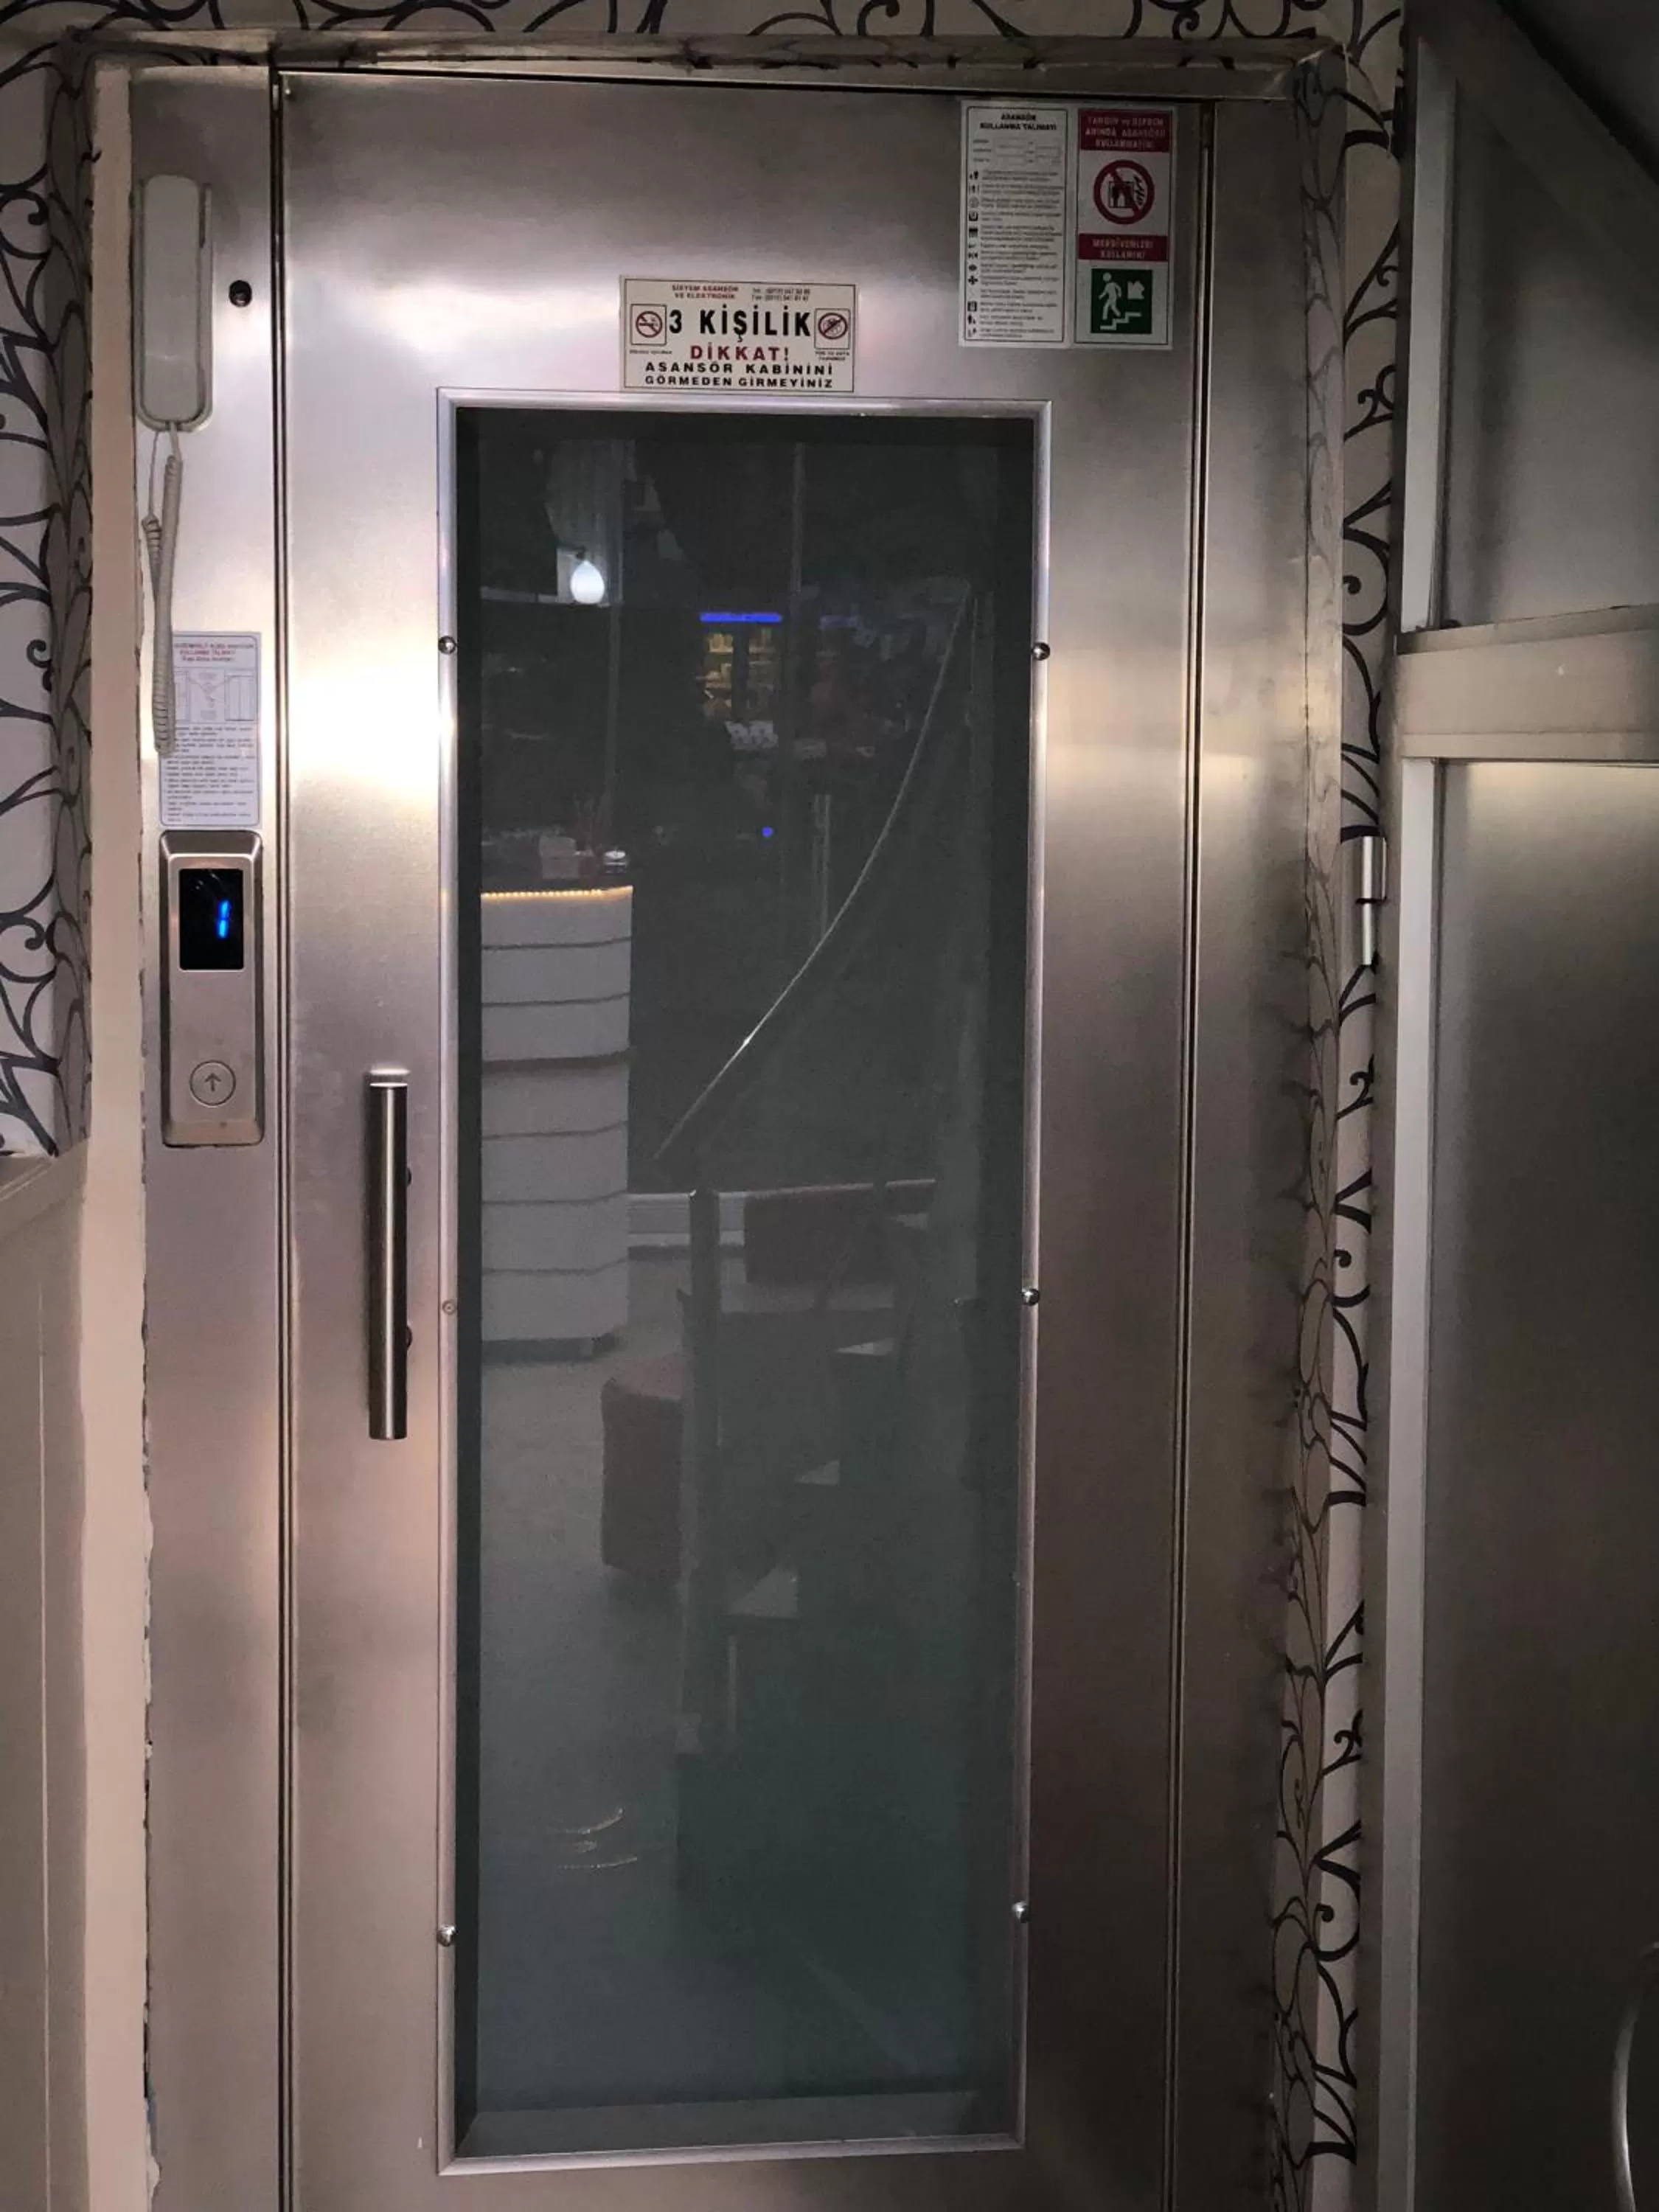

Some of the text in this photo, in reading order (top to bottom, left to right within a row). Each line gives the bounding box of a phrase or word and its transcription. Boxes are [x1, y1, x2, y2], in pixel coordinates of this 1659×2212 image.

[669, 303, 811, 342] 3 KİŞİLİK
[690, 342, 790, 361] DİKKAT!
[645, 361, 833, 375] ASANSÖR KABİNİNİ
[645, 375, 832, 389] GÖRMEDEN GİRMEYİNİZ
